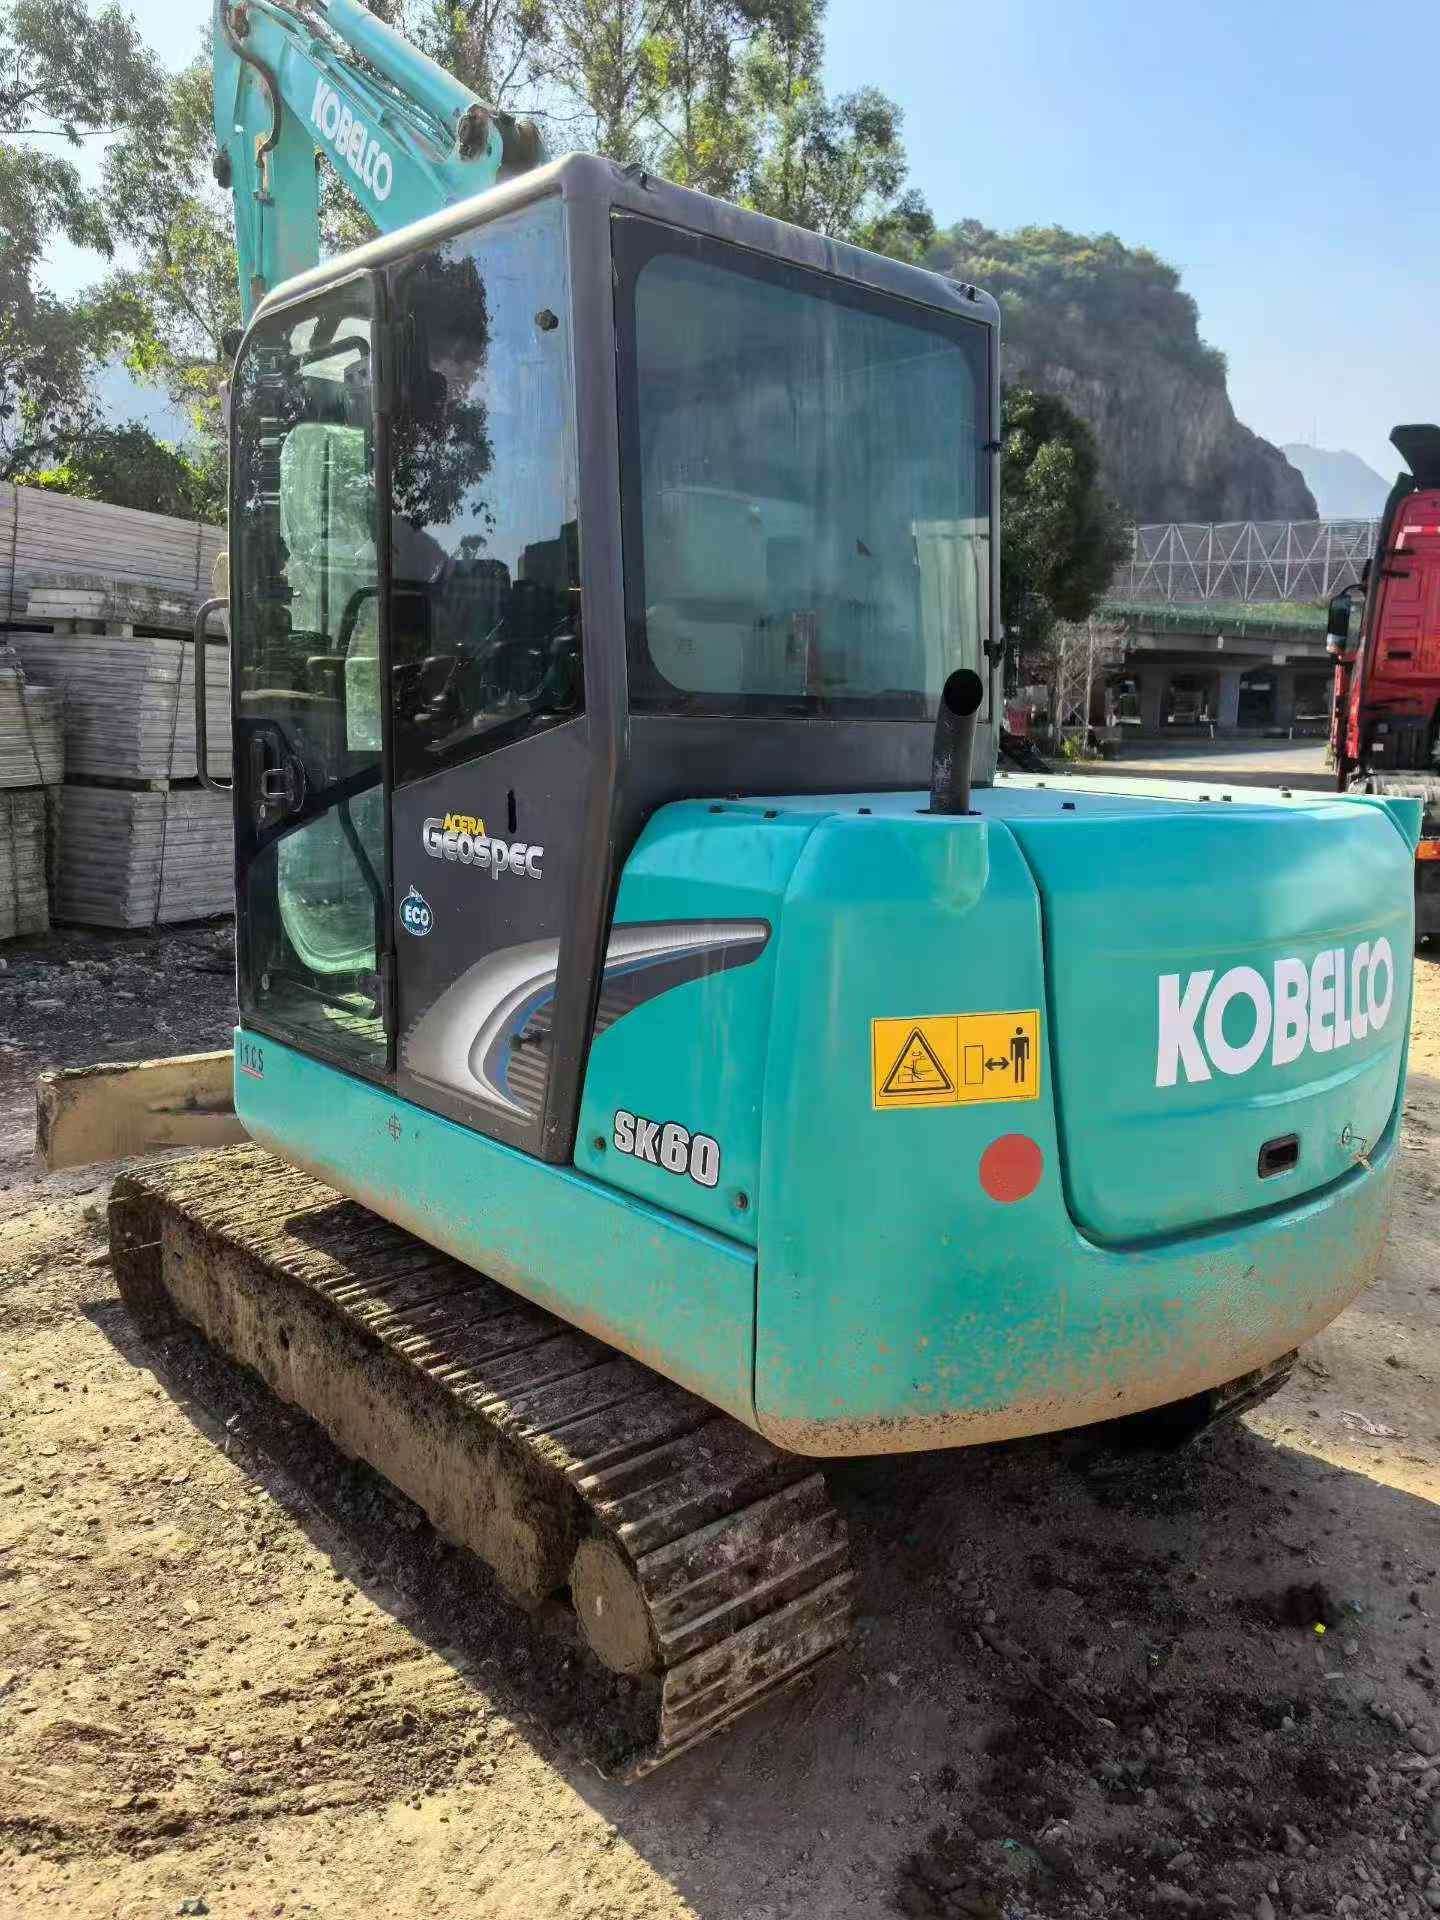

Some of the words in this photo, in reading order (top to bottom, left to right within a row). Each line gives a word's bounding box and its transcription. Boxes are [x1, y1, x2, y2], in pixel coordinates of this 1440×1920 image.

[311, 77, 393, 201] KOBELCO
[443, 813, 486, 838] ACERA
[405, 905, 429, 926] ECO
[1156, 937, 1394, 1087] KOBELCO
[614, 1109, 720, 1188] SK60
